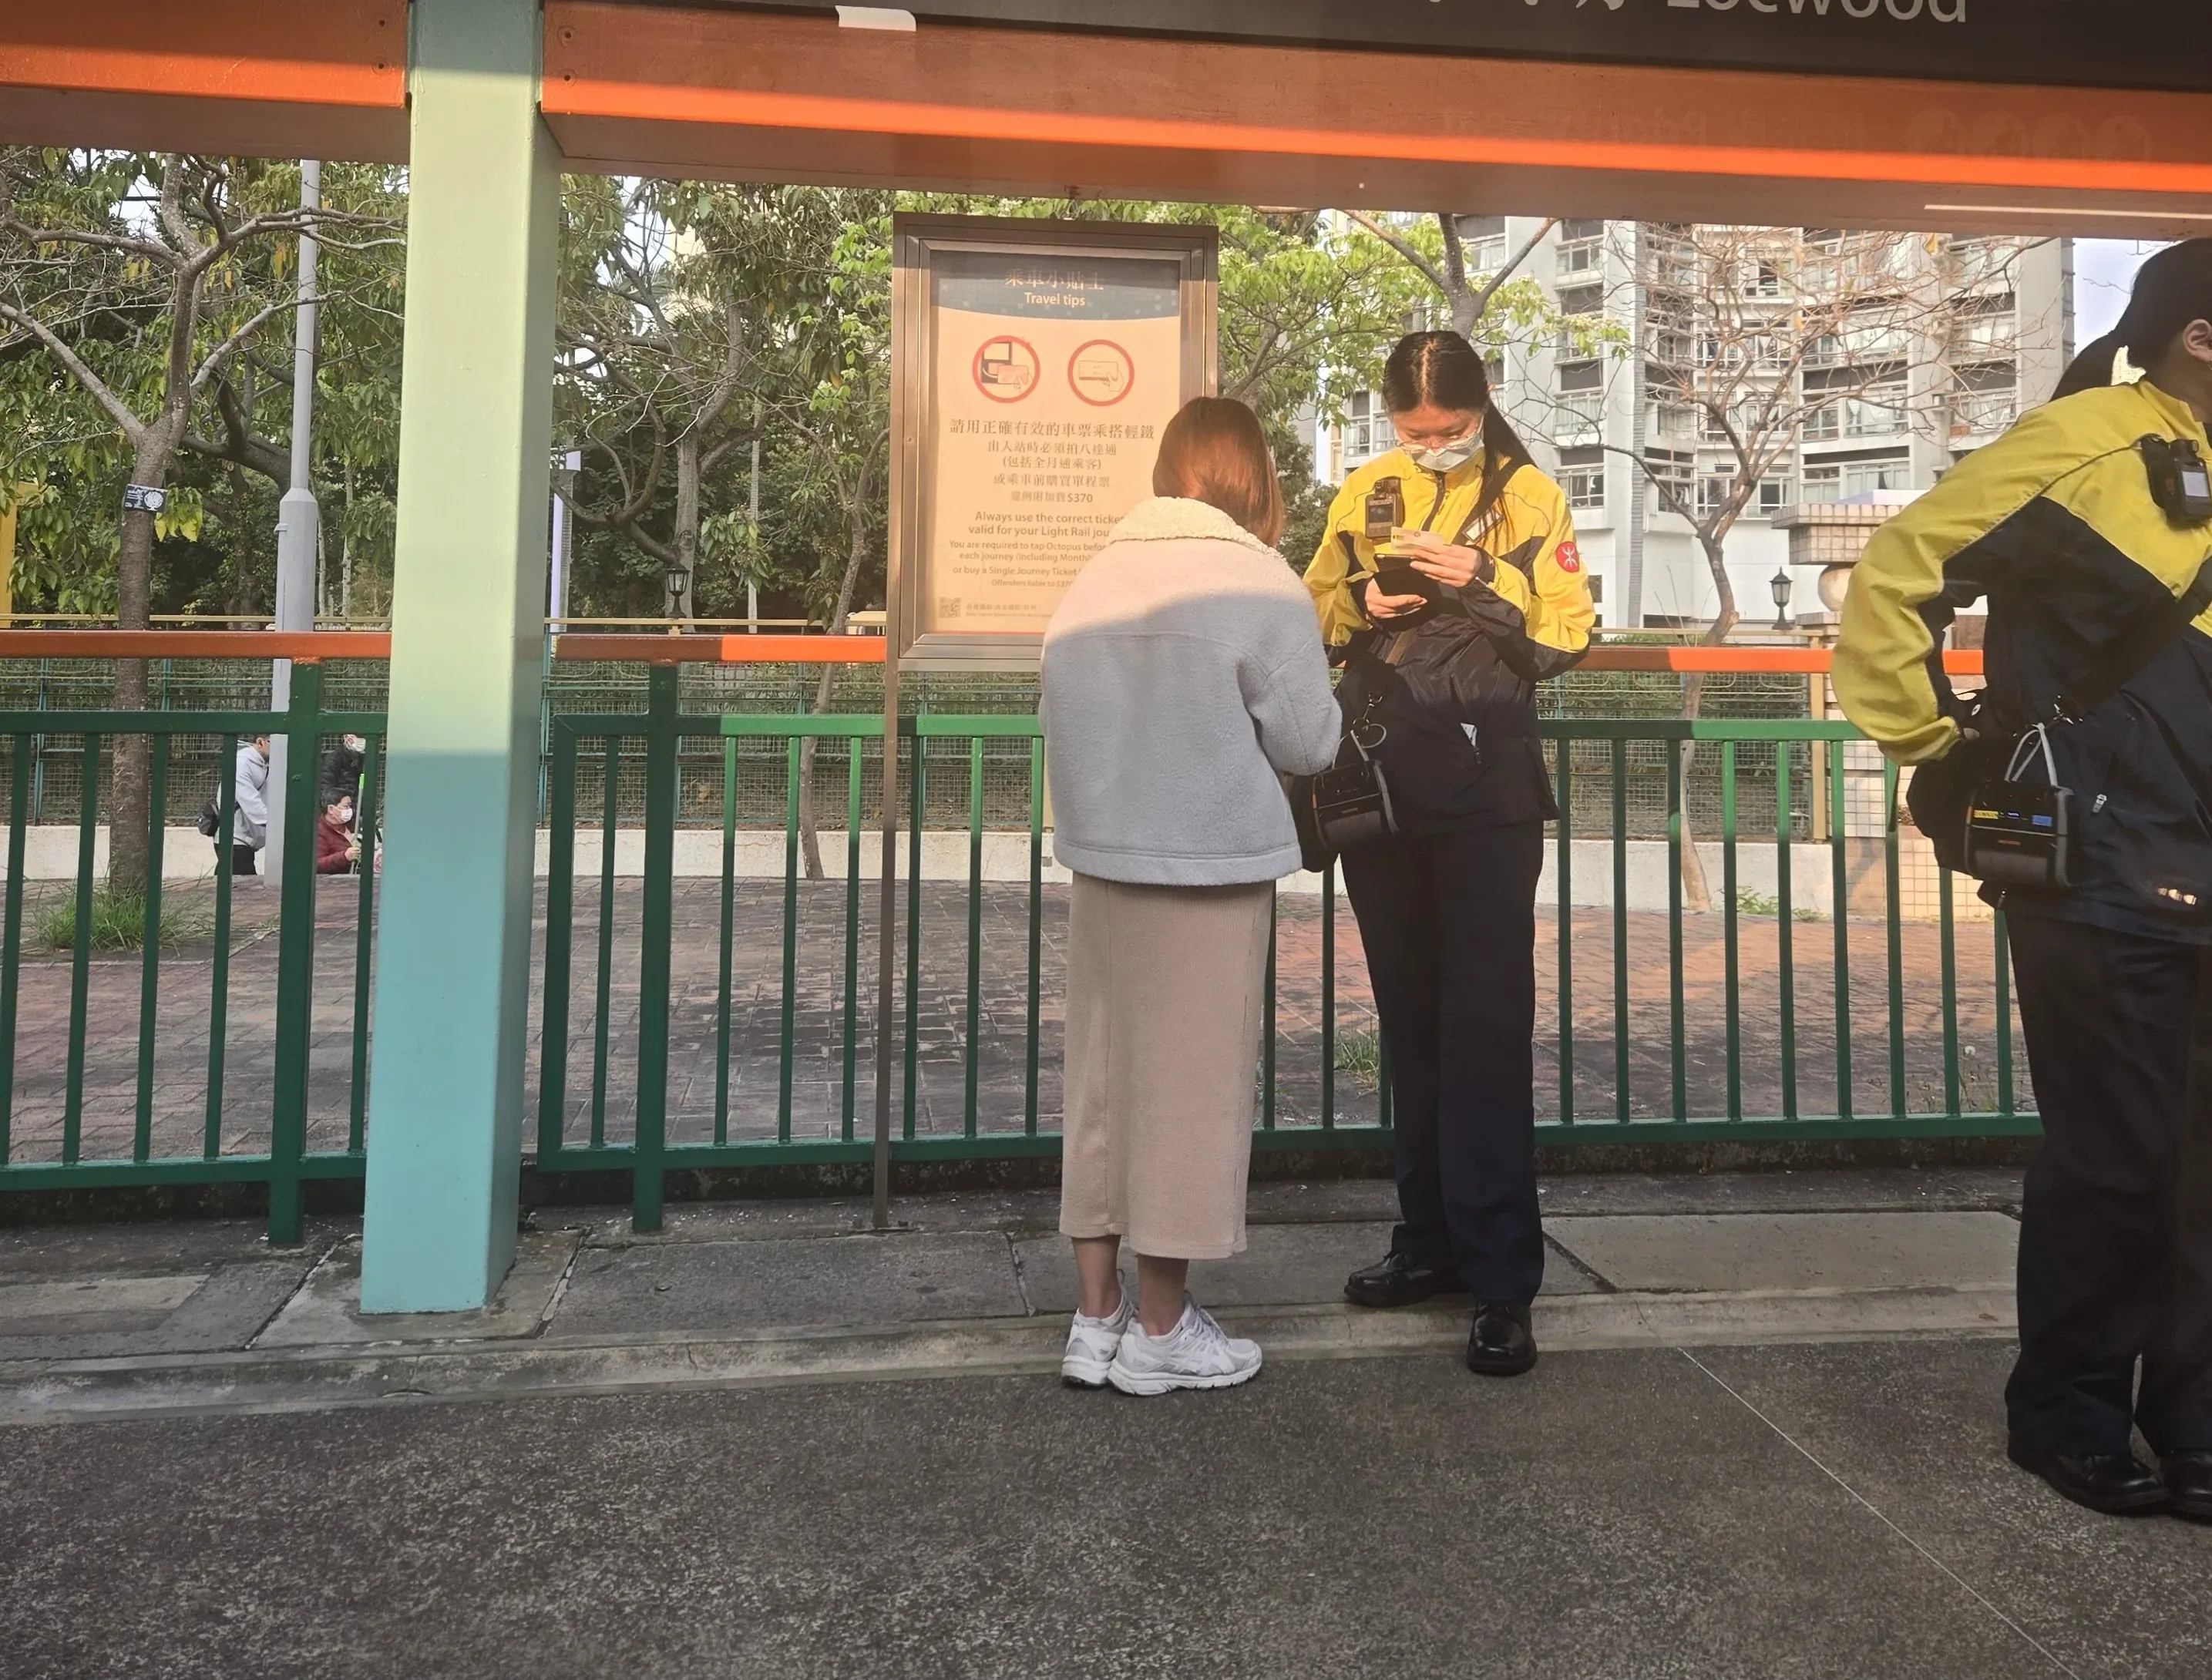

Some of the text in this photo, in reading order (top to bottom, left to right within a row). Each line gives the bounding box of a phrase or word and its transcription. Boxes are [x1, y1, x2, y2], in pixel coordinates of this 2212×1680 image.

[1005, 268, 1105, 291] 乘車小貼士
[1024, 292, 1086, 308] Travel tips
[950, 418, 1155, 440] 請用正確有效的車票乘搭輕鐵
[987, 439, 1117, 455] 出入站時必須拍八達通
[1003, 455, 1101, 470] (包括全月通乘客)
[993, 472, 1110, 488] 或乘車前購買單程票
[975, 511, 1013, 524] Always
[1014, 513, 1034, 522] use
[1036, 512, 1054, 522] the
[1056, 515, 1093, 523] correct
[968, 525, 1110, 539] valid for your Light Rail jou
[949, 539, 965, 548] You
[982, 540, 1018, 550] required
[1030, 543, 1045, 552] tap
[1047, 542, 1082, 552] Octopus
[1084, 543, 1106, 551] befor
[981, 553, 1014, 563] journey
[1016, 553, 1058, 563] (including
[963, 566, 980, 576] buy
[989, 566, 1016, 576] Single
[1017, 567, 1051, 578] Journey
[1053, 567, 1077, 576] Ticket
